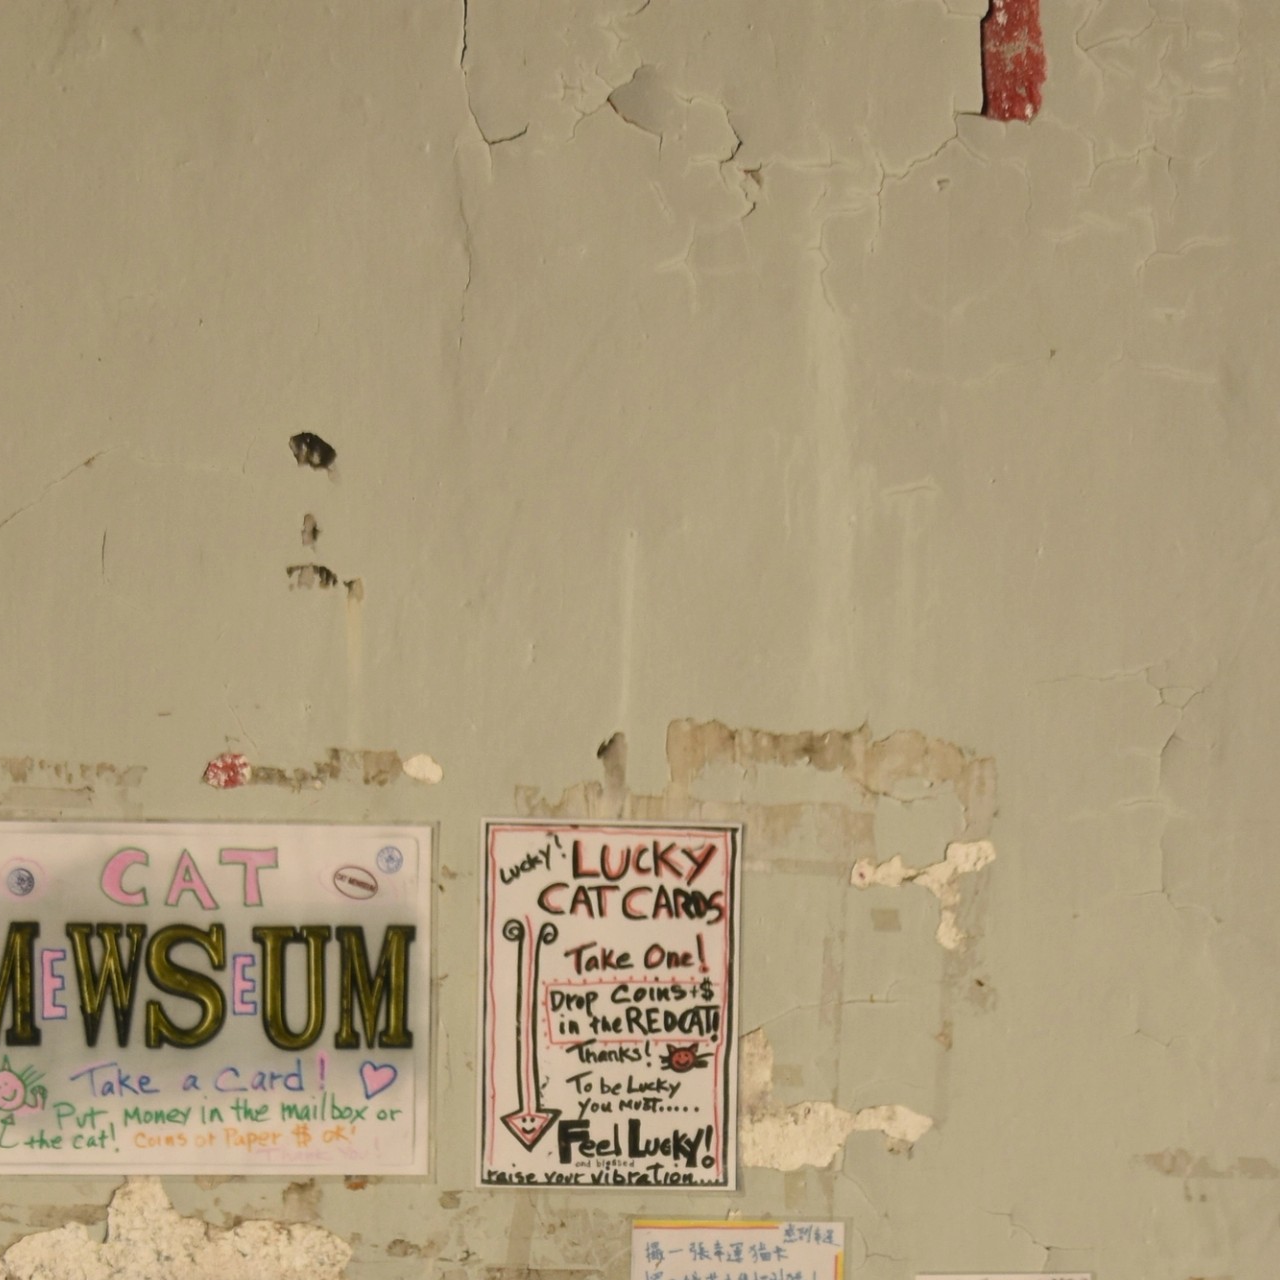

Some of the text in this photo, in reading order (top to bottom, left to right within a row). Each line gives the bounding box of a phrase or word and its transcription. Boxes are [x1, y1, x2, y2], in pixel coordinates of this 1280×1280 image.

[101, 846, 279, 910] CAT
[572, 839, 718, 887] LUCKY
[537, 882, 725, 925] CAT CARDS
[564, 933, 710, 975] Take One!
[549, 990, 599, 1017] Drop
[559, 1013, 581, 1034] in
[588, 1014, 624, 1034] the
[565, 1038, 652, 1067] Thanks!
[70, 1061, 160, 1100] Take
[184, 1073, 202, 1090] a
[565, 1071, 681, 1099] To be Lucky
[53, 1103, 110, 1128] Put
[199, 1096, 226, 1126] in
[230, 1101, 271, 1124] the
[281, 1091, 367, 1123] mailbox
[378, 1106, 404, 1122] or
[23, 1130, 63, 1151] the
[72, 1126, 119, 1153] cat!
[224, 1128, 283, 1150] Paper
[291, 1124, 312, 1147] $
[558, 1118, 621, 1164] Feel
[486, 1162, 536, 1183] raise
[544, 1169, 587, 1185] your
